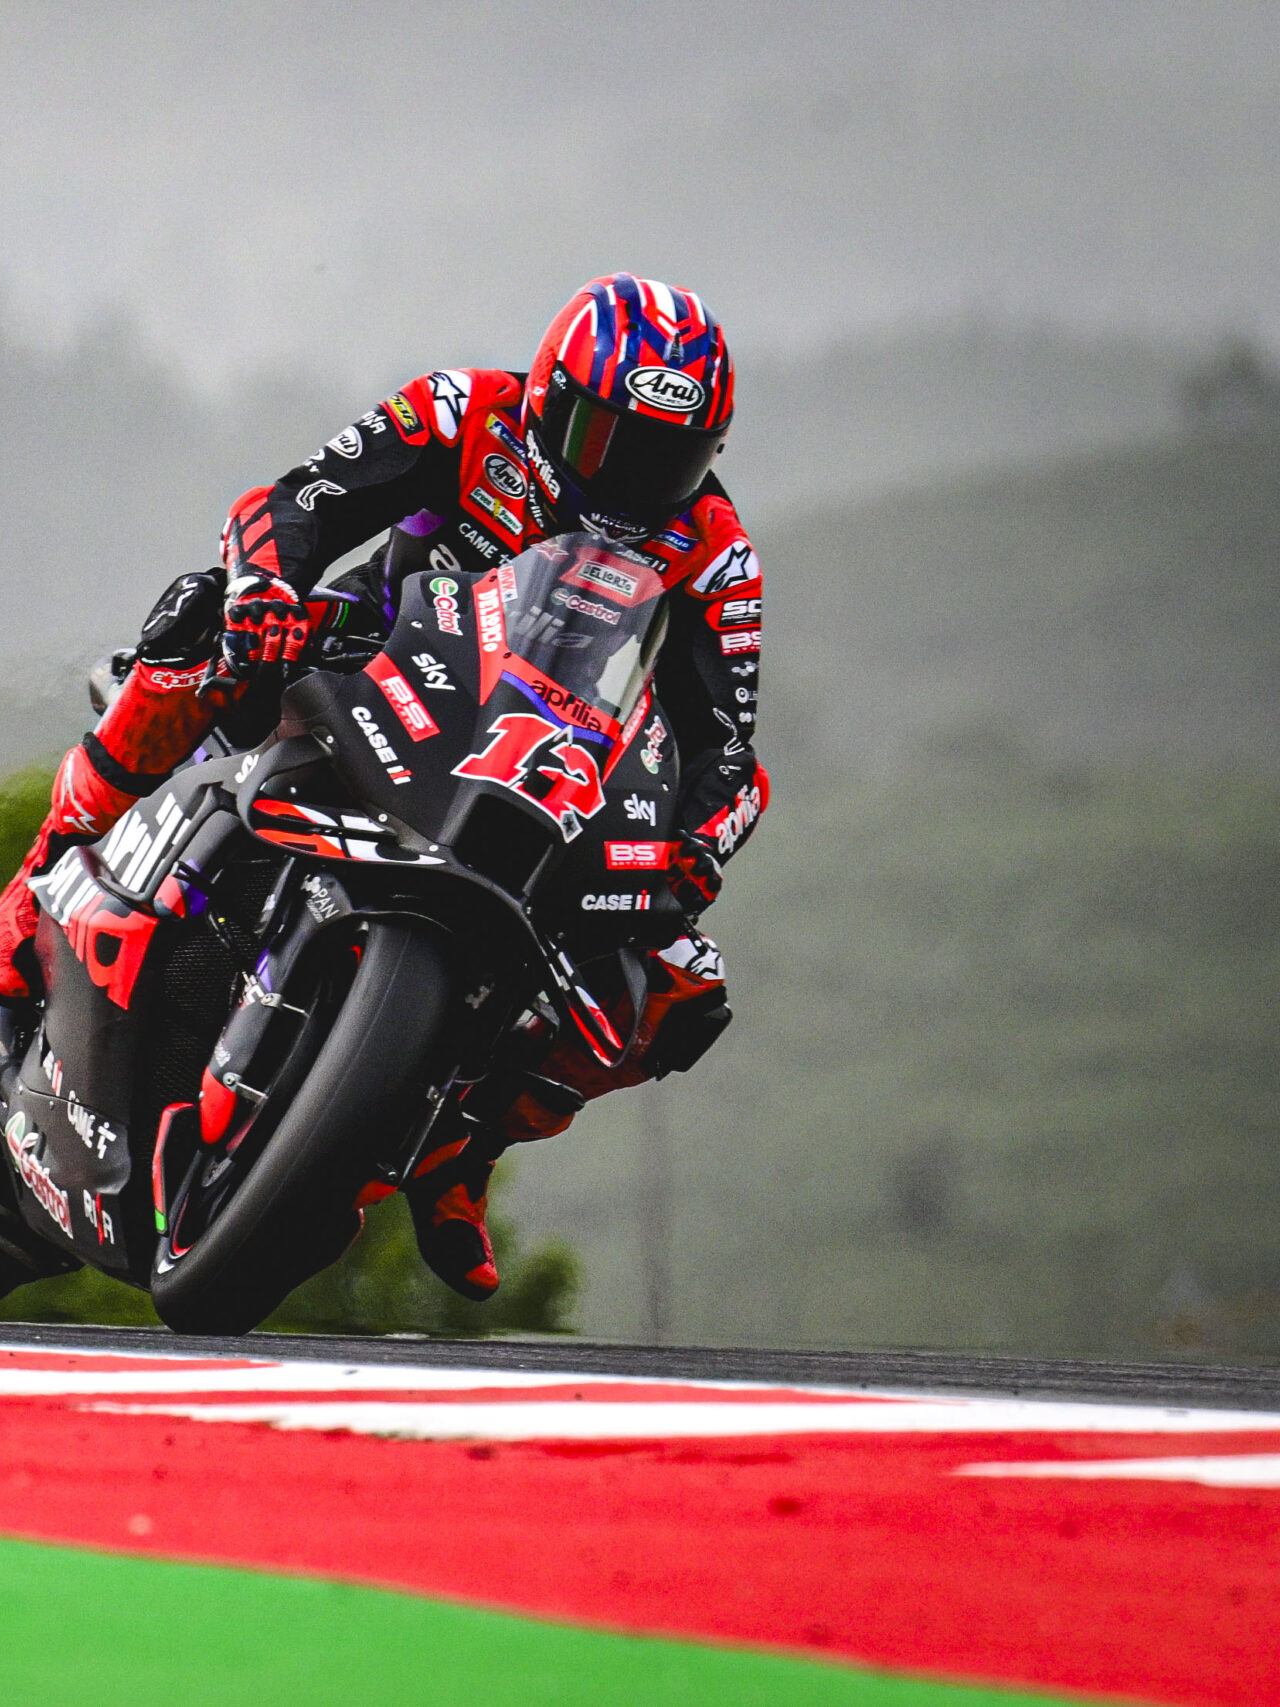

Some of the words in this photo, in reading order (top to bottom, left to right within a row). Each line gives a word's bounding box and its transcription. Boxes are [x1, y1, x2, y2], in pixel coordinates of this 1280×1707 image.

[633, 373, 699, 401] Arai
[488, 461, 521, 491] Arai
[458, 522, 498, 559] CAME
[433, 594, 463, 636] Ctrol
[565, 594, 622, 626] Castrol
[411, 653, 457, 691] sky
[385, 675, 432, 730] BS
[530, 679, 602, 732] aprilia
[351, 706, 399, 764] CASE
[450, 713, 607, 843] 12
[623, 793, 656, 827] sky
[609, 844, 656, 861] BS
[581, 894, 633, 911] CASE
